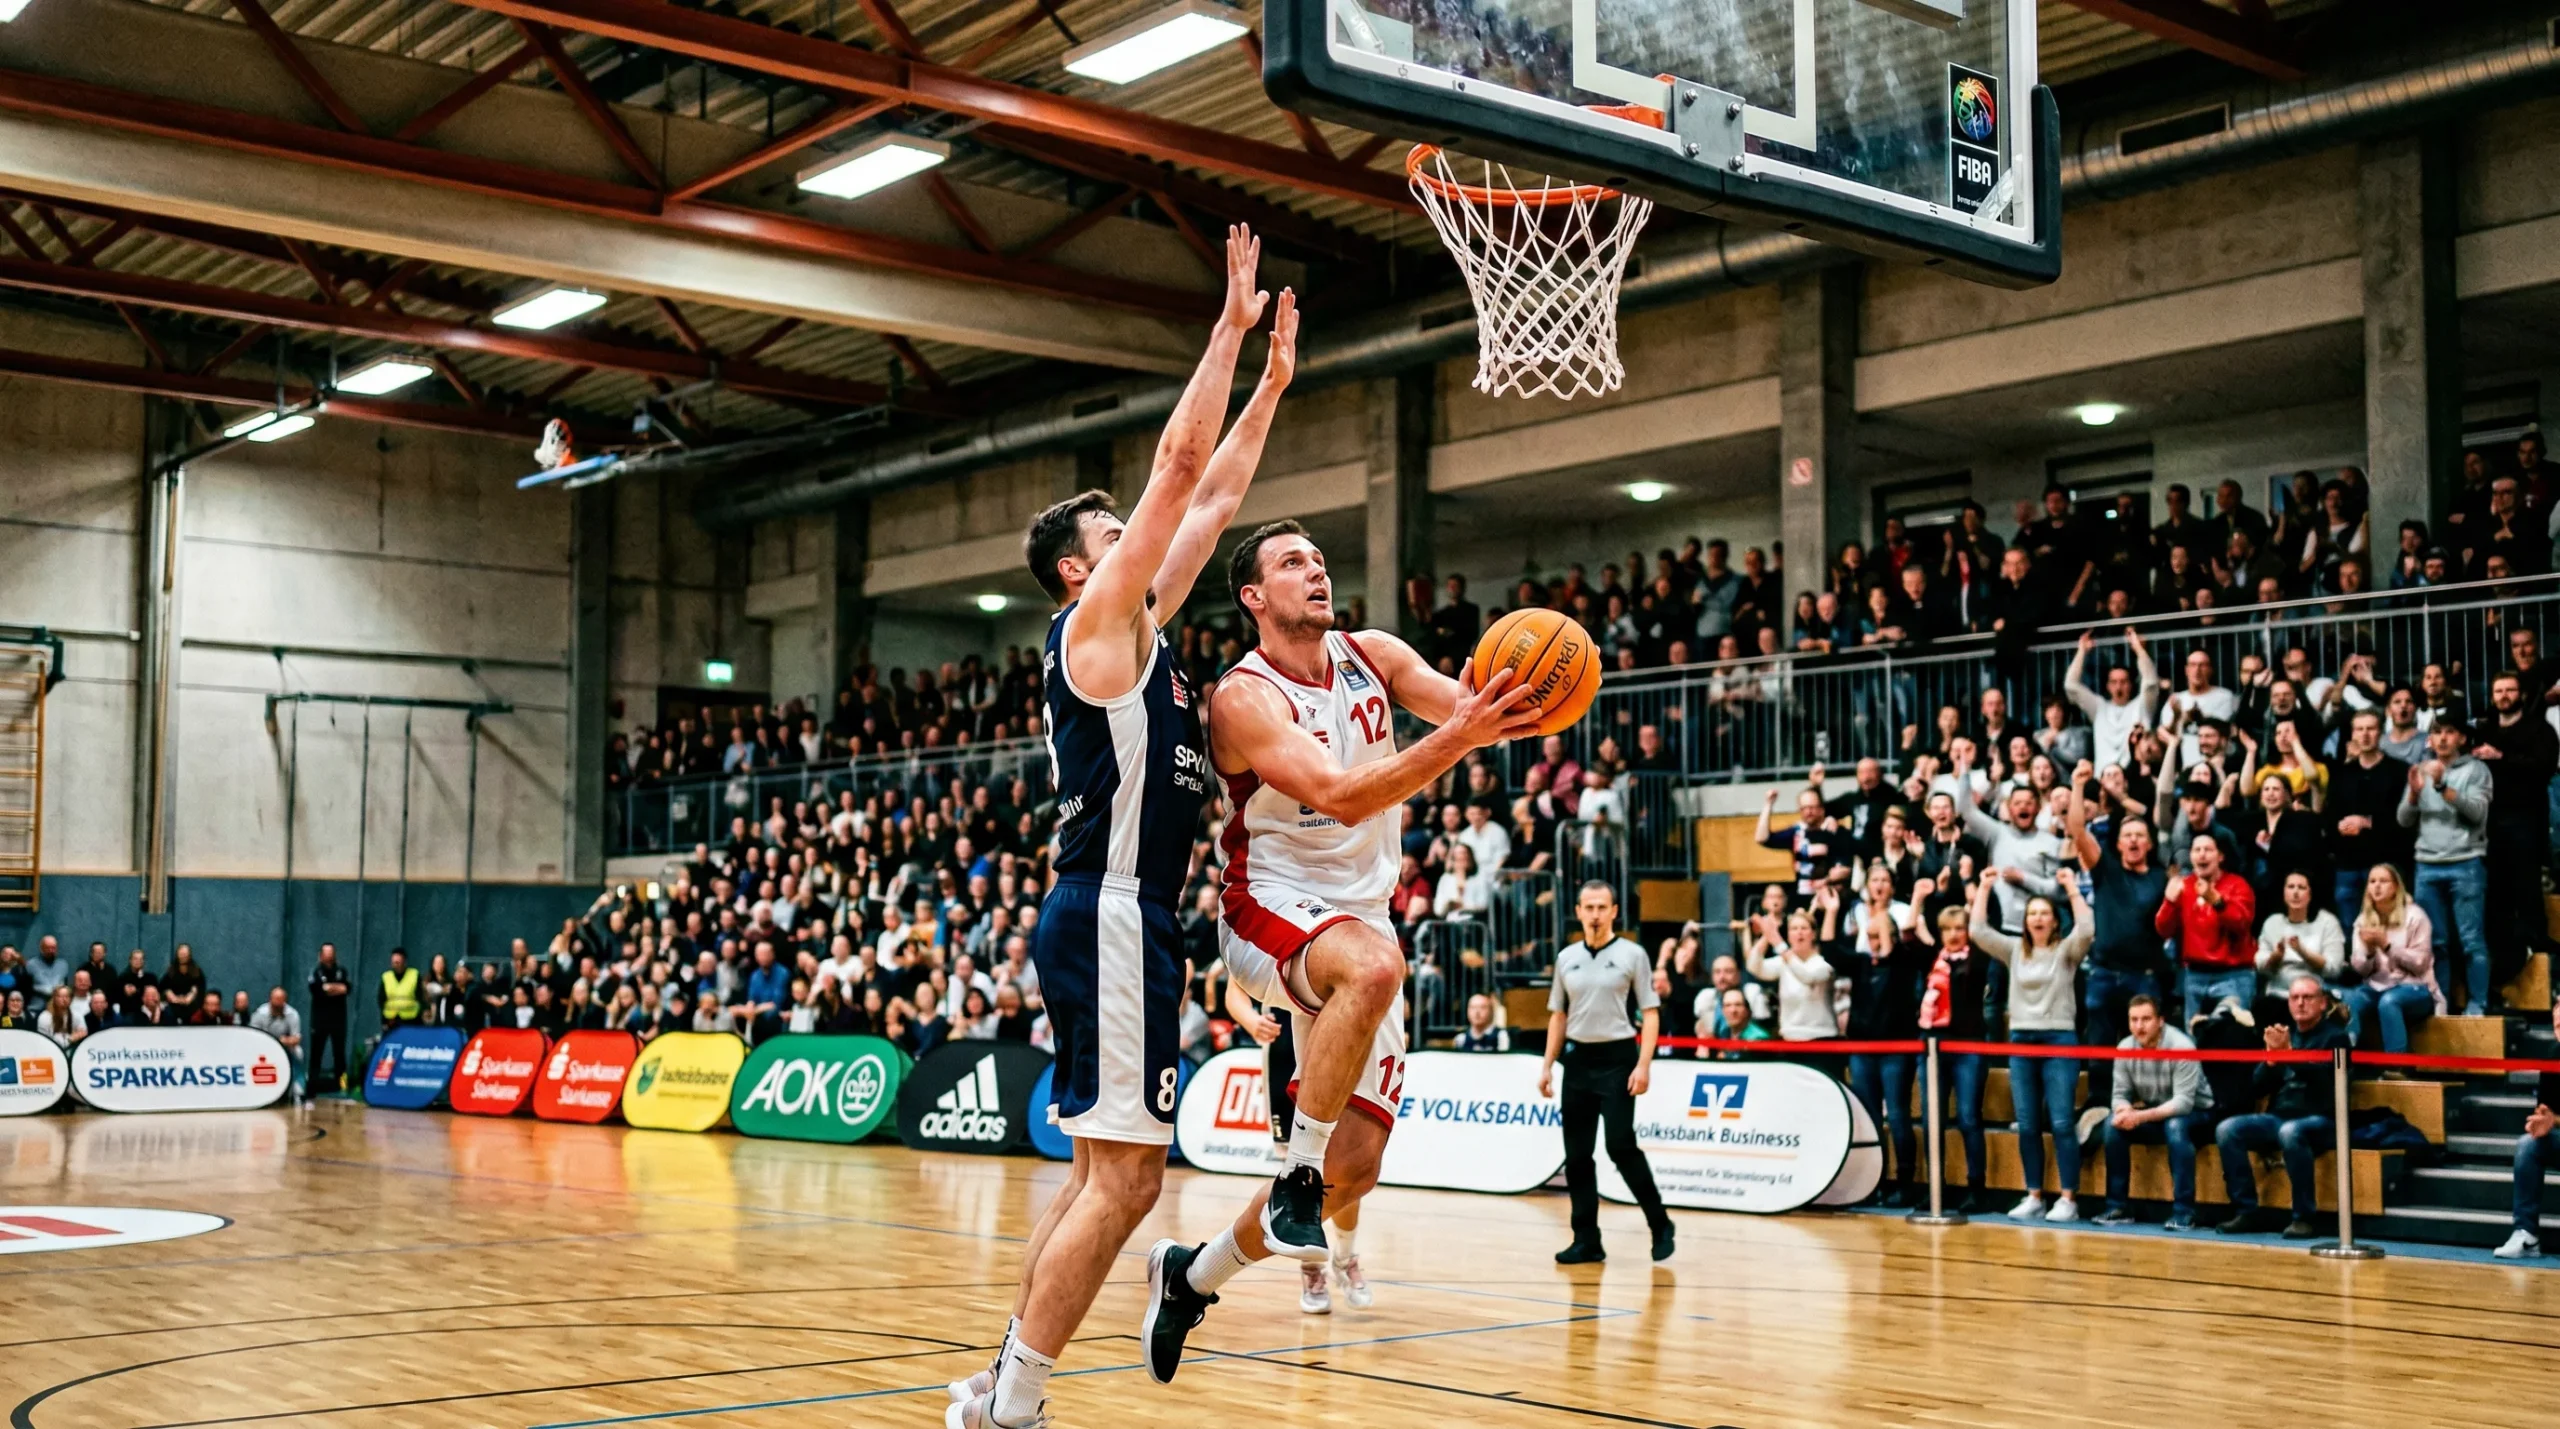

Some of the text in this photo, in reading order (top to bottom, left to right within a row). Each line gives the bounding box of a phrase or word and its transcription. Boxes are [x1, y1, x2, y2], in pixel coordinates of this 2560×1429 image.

[1958, 154, 1992, 187] FIBA
[1525, 636, 1579, 708] SPALDING
[1350, 696, 1388, 745] 12
[89, 1065, 247, 1089] SPARKASSE
[741, 1058, 845, 1115] AOK
[1157, 1066, 1178, 1112] 8
[920, 1107, 1007, 1143] adidas
[1422, 1097, 1563, 1127] VOLKSBANK
